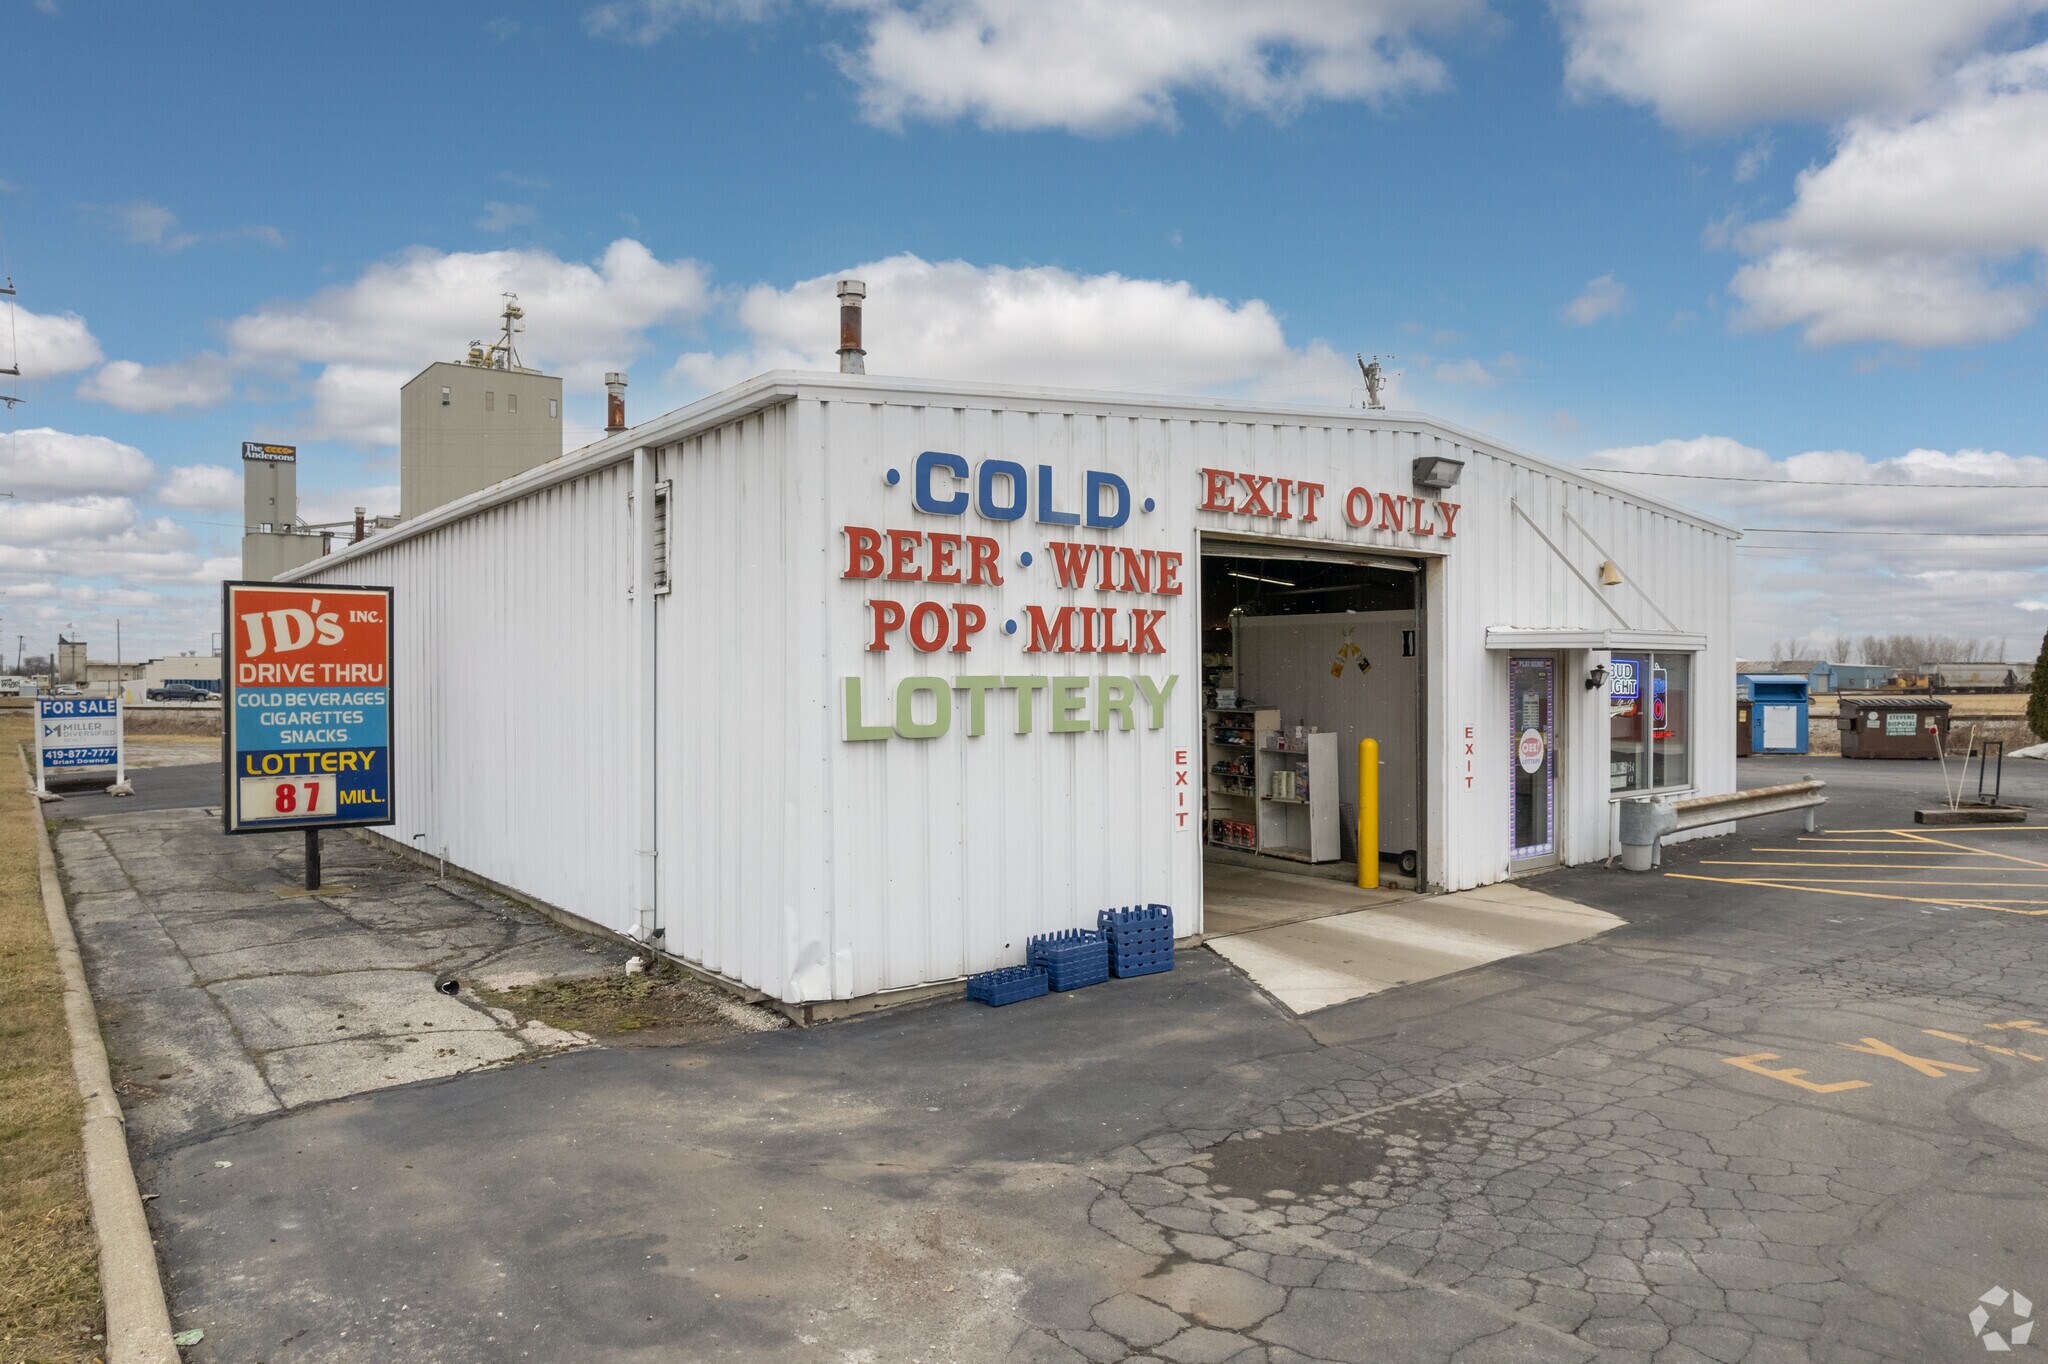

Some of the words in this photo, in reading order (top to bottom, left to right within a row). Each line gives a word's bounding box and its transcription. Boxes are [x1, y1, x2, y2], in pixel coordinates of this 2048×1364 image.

[244, 450, 294, 461] Andersons
[245, 443, 263, 452] The
[911, 450, 1131, 530] COLD
[1196, 467, 1324, 522] EXIT
[1341, 486, 1461, 538] ONLY
[840, 525, 1005, 587] BEER
[1044, 541, 1183, 596] WINE
[241, 598, 345, 658] JD's
[349, 610, 383, 624] INC.
[865, 599, 987, 654] POP
[1022, 605, 1167, 655] MILK
[239, 663, 315, 684] DRIVE
[319, 663, 383, 683] THRU
[1611, 679, 1637, 695] IGHT
[43, 701, 74, 715] FOR
[79, 700, 116, 714] SALE
[237, 692, 283, 708] COLD
[285, 692, 386, 706] BEVERAGES
[840, 674, 1180, 742] LOTTERY
[260, 711, 364, 726] CIGARETTES
[63, 723, 102, 731] MILLER
[63, 730, 117, 738] DIVERSIFIED
[280, 729, 348, 744] SNACKS
[45, 748, 117, 759] 419-877-7777
[1465, 727, 1474, 789] EXIT
[246, 750, 376, 775] LOTTERY
[339, 789, 385, 805] MILL.
[1175, 751, 1189, 827] EXIT
